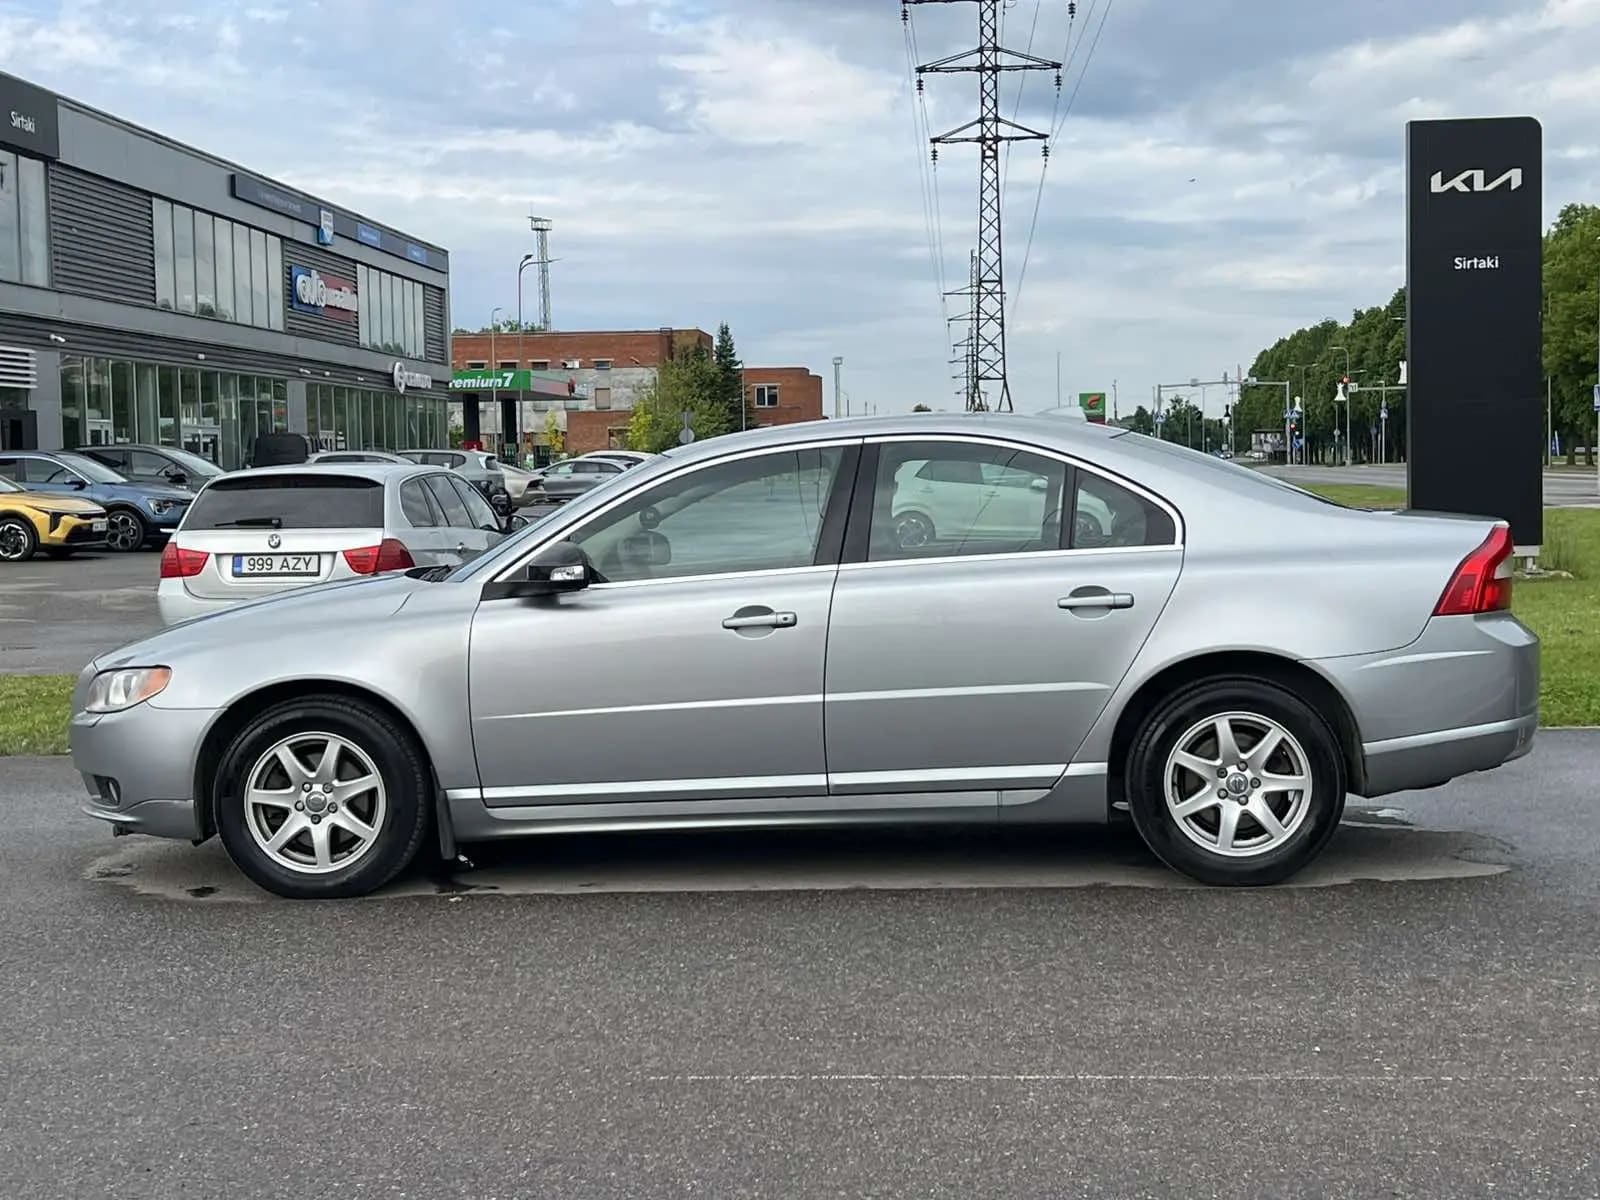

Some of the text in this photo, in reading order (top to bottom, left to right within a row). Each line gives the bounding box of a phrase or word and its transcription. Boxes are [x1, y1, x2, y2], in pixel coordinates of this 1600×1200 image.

[10, 111, 35, 133] Sirtaki
[1430, 167, 1523, 193] KIA
[1453, 256, 1500, 270] Sirtaki
[448, 372, 514, 389] remium7
[247, 556, 312, 571] 999 AZY
